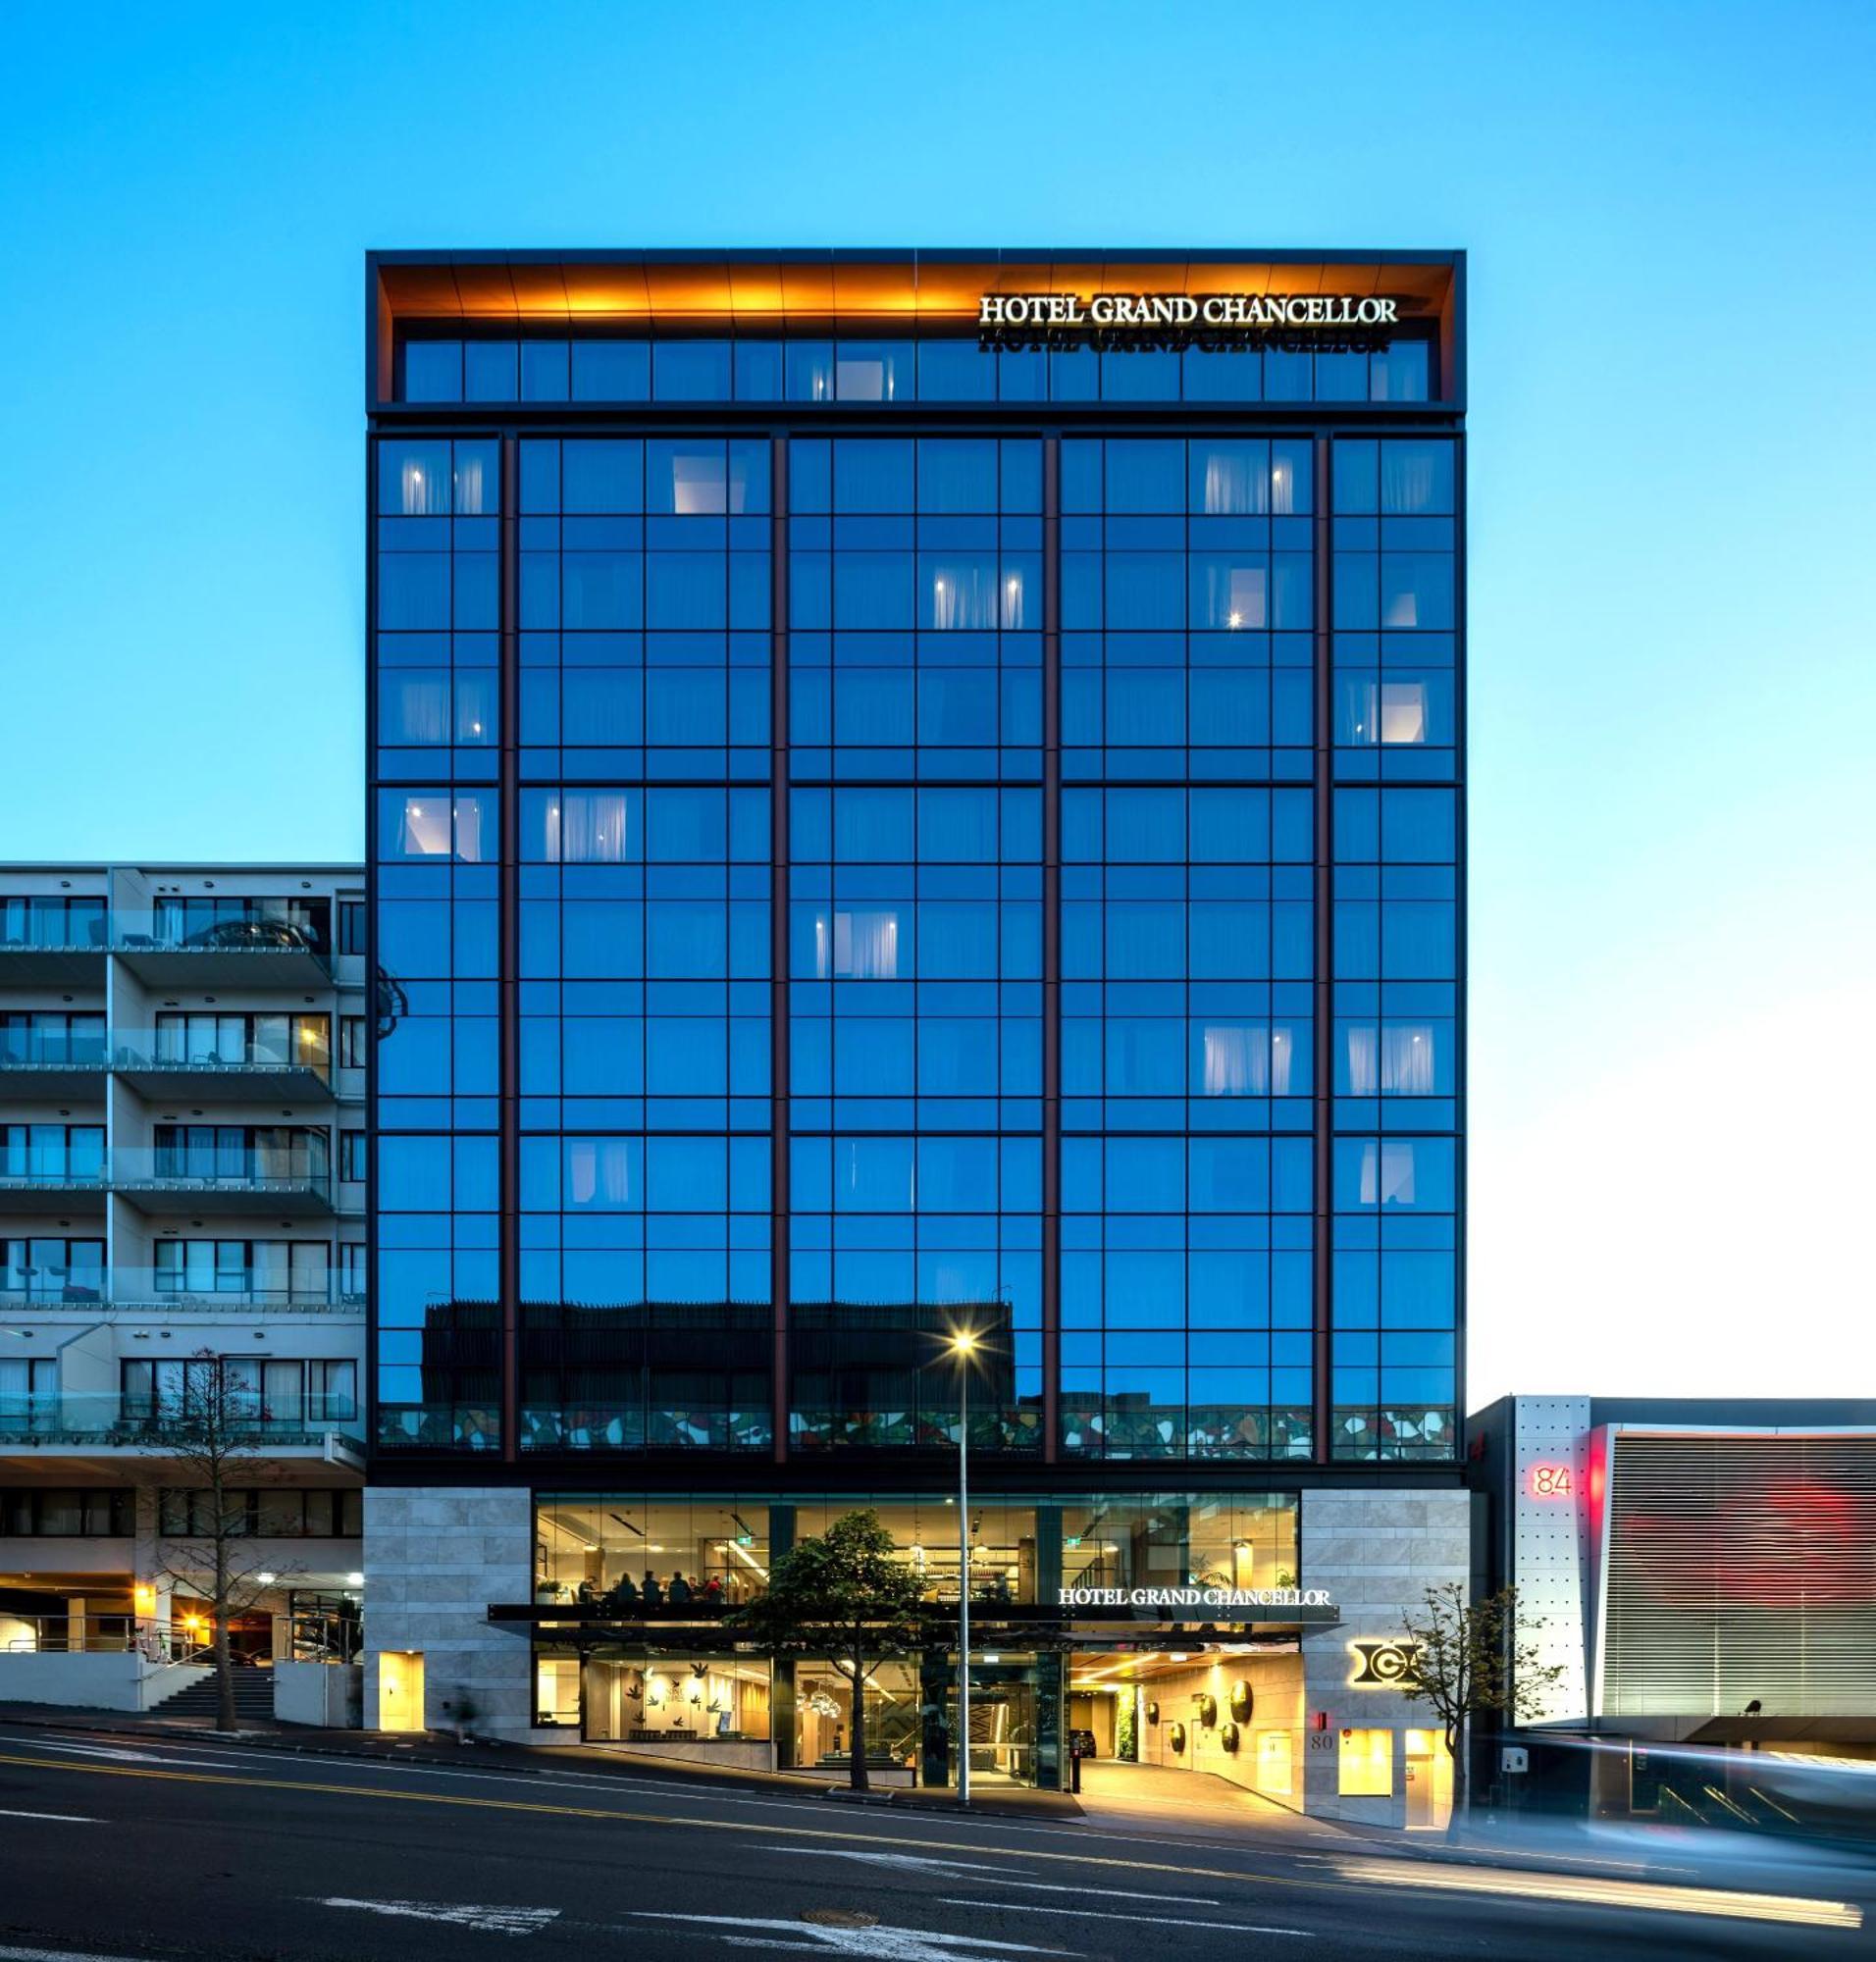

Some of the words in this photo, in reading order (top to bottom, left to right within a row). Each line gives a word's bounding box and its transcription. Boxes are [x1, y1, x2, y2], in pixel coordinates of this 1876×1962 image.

[980, 297, 1085, 323] HOTEL
[1091, 297, 1198, 323] GRAND
[1203, 298, 1398, 324] CHANCELLOR
[1537, 1468, 1572, 1494] 84
[1059, 1588, 1128, 1605] HOTEL
[1130, 1588, 1201, 1605] GRAND
[1203, 1589, 1331, 1606] CHANCELLOR
[1311, 1735, 1333, 1750] 80
